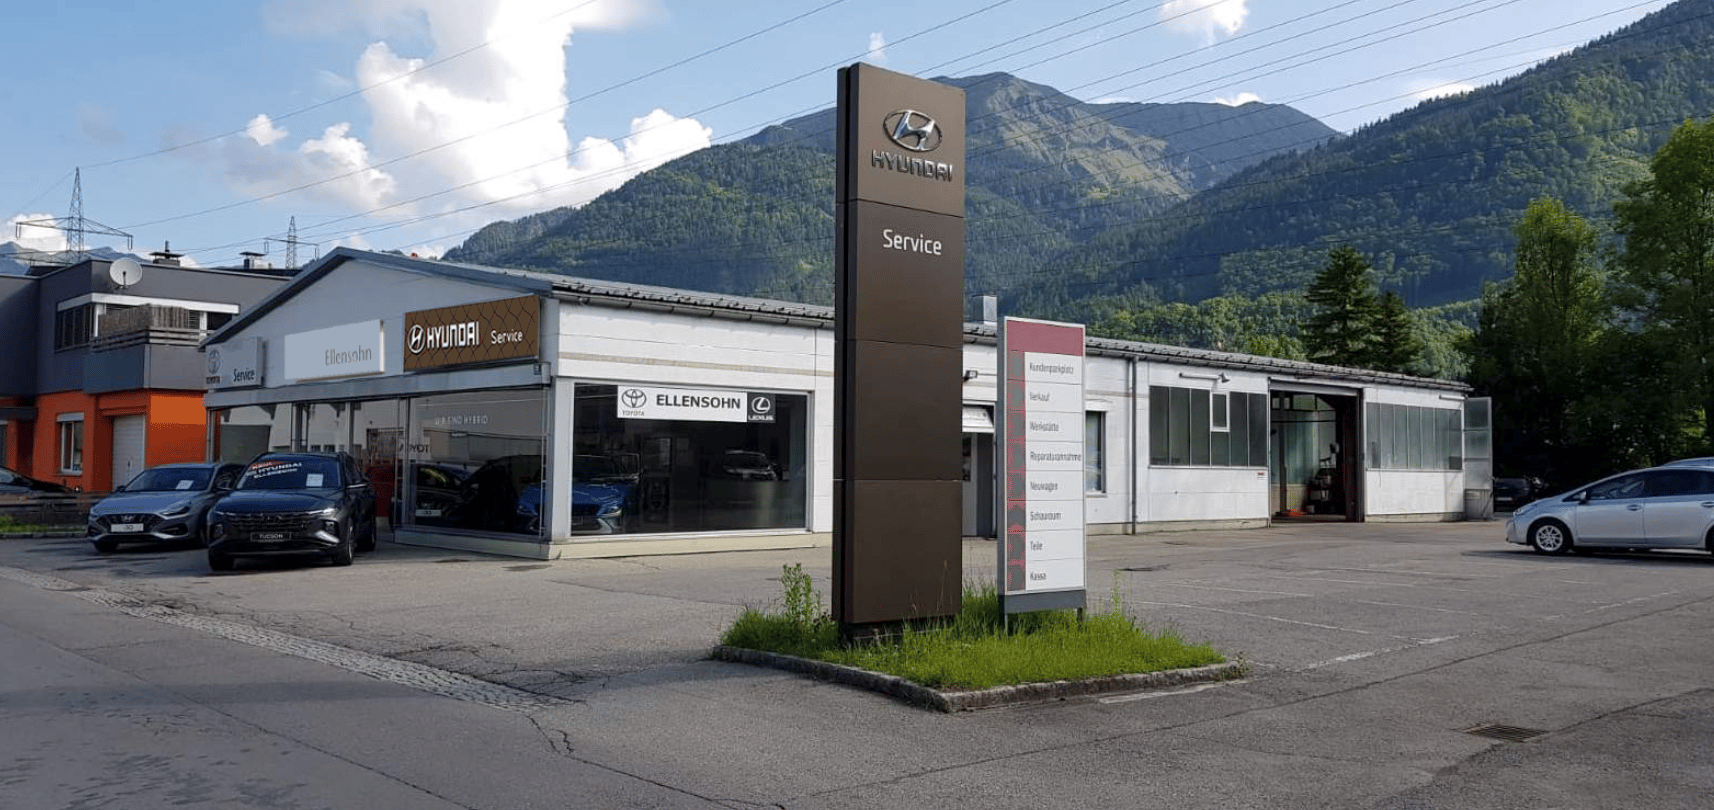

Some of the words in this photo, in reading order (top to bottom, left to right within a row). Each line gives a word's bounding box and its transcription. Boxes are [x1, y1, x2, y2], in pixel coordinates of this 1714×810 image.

[871, 149, 953, 182] HYUNDAI
[883, 228, 942, 255] Service
[426, 321, 480, 349] HYUNDAI
[491, 329, 523, 344] Service
[325, 345, 372, 366] Ellensohn
[233, 368, 255, 382] Service
[1029, 363, 1075, 375] Kundenparkplatz
[656, 394, 741, 409] ELLENSOHN
[1029, 421, 1060, 432] Werkstätte
[1029, 481, 1059, 492] Neuwagen
[1029, 511, 1062, 521] Schauraum
[1029, 541, 1043, 551] Teile
[1029, 571, 1047, 581] Kassa
